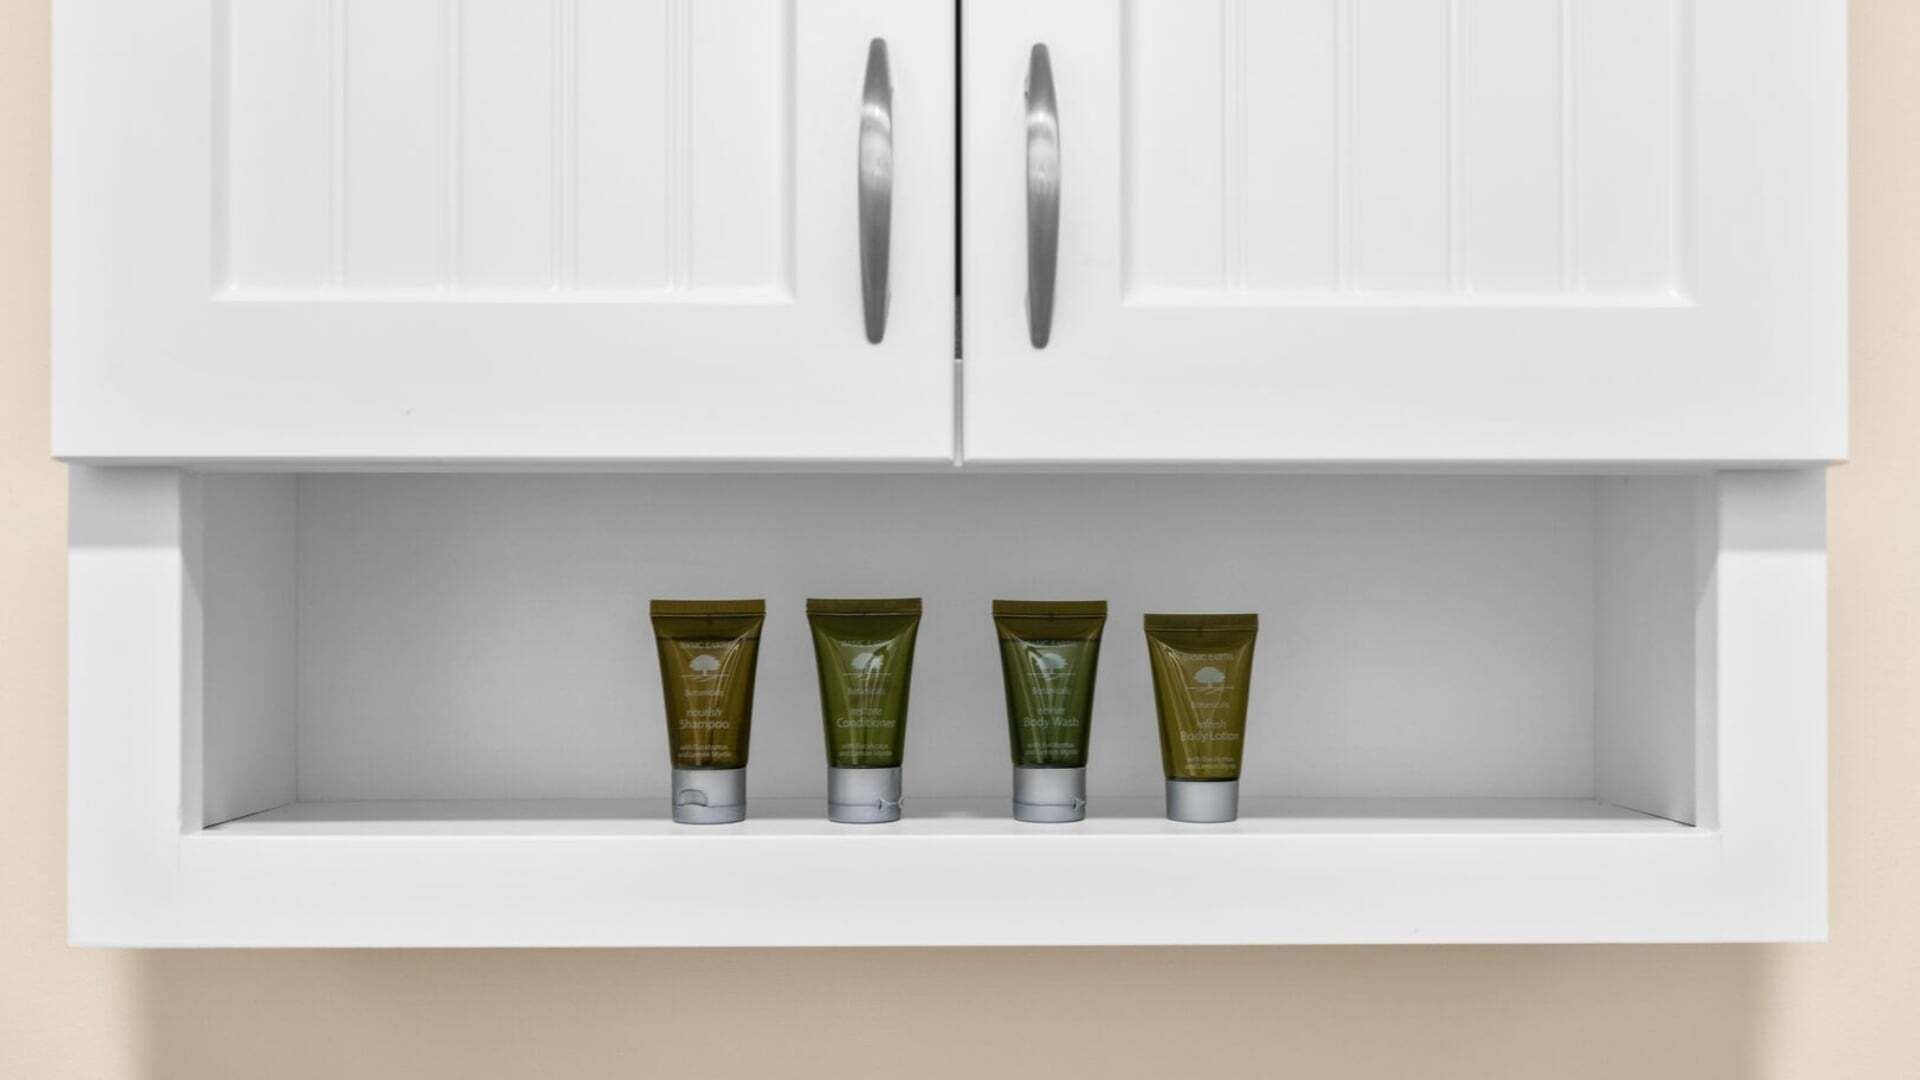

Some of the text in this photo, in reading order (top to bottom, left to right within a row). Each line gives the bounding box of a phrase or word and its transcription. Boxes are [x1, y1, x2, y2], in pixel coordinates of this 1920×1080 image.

[679, 719, 729, 730] Shampoo
[836, 717, 896, 728] Conditioner
[1024, 717, 1080, 730] Body Wash
[1180, 731, 1206, 742] Body
